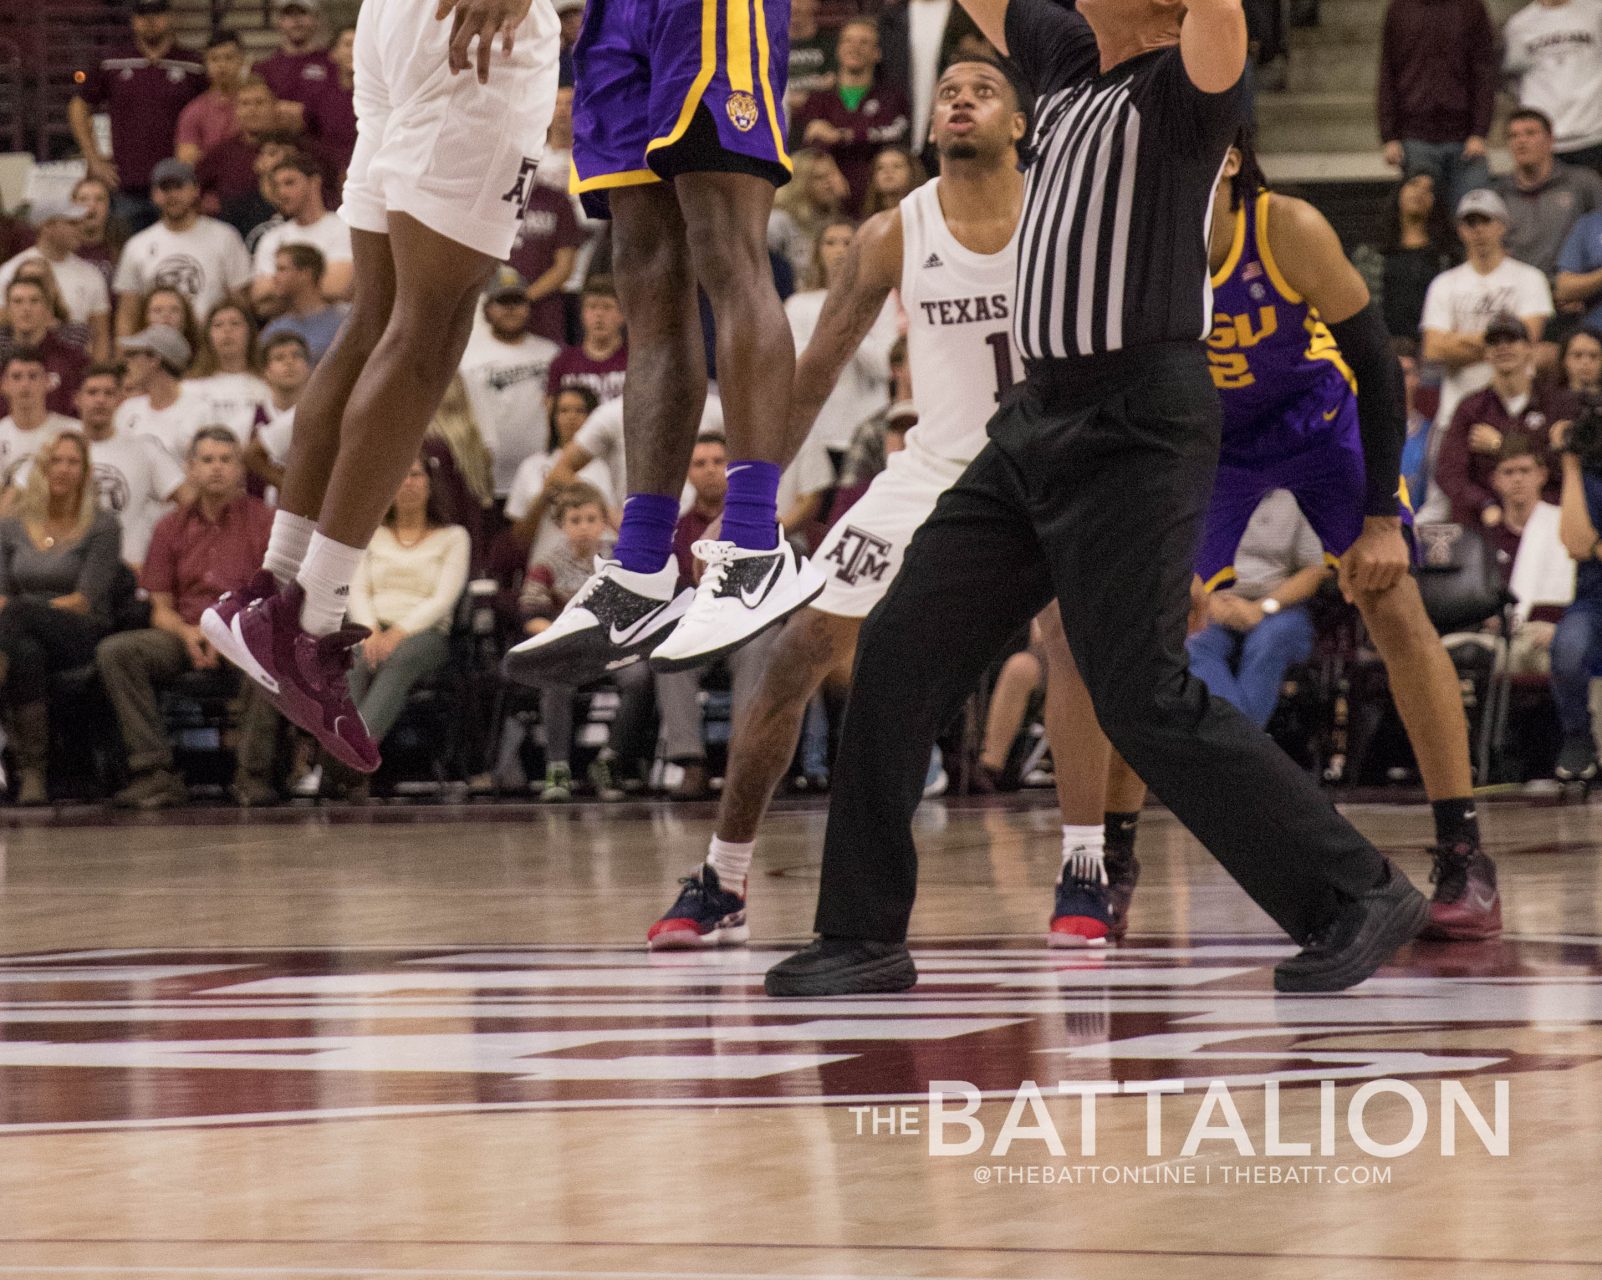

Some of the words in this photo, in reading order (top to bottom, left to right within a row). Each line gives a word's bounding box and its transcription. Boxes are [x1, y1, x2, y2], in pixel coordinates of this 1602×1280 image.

[920, 293, 1009, 325] TEXAS
[1206, 305, 1278, 349] SU
[985, 330, 1014, 404] 1
